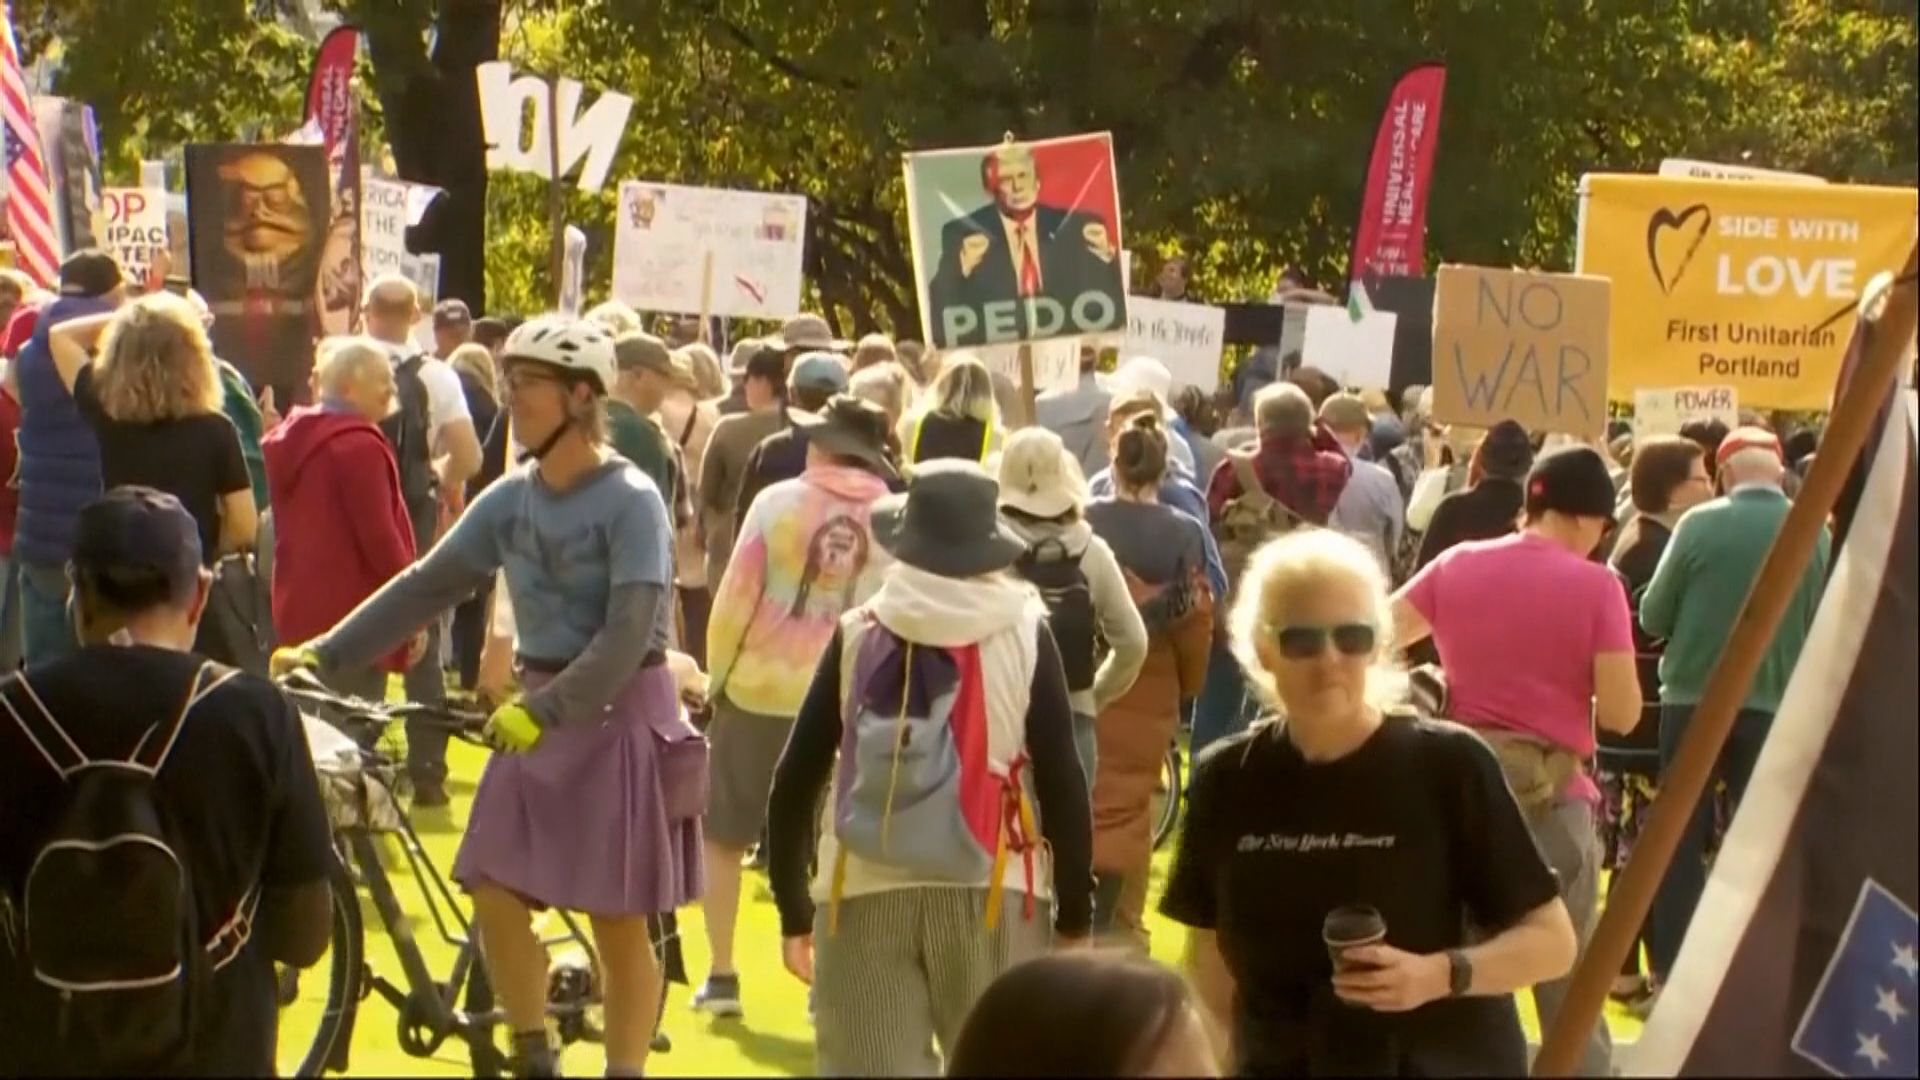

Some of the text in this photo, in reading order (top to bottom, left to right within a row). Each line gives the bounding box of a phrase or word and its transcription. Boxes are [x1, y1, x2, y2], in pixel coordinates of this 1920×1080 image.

[1717, 215, 1860, 242] SIDE WITH
[1716, 254, 1858, 298] LOVE
[942, 290, 1116, 347] PEDO
[1477, 275, 1563, 332] NO
[1666, 319, 1835, 348] First Unitarian
[1453, 340, 1591, 422] WAR
[1699, 353, 1800, 378] Portland
[1674, 388, 1731, 410] POWER
